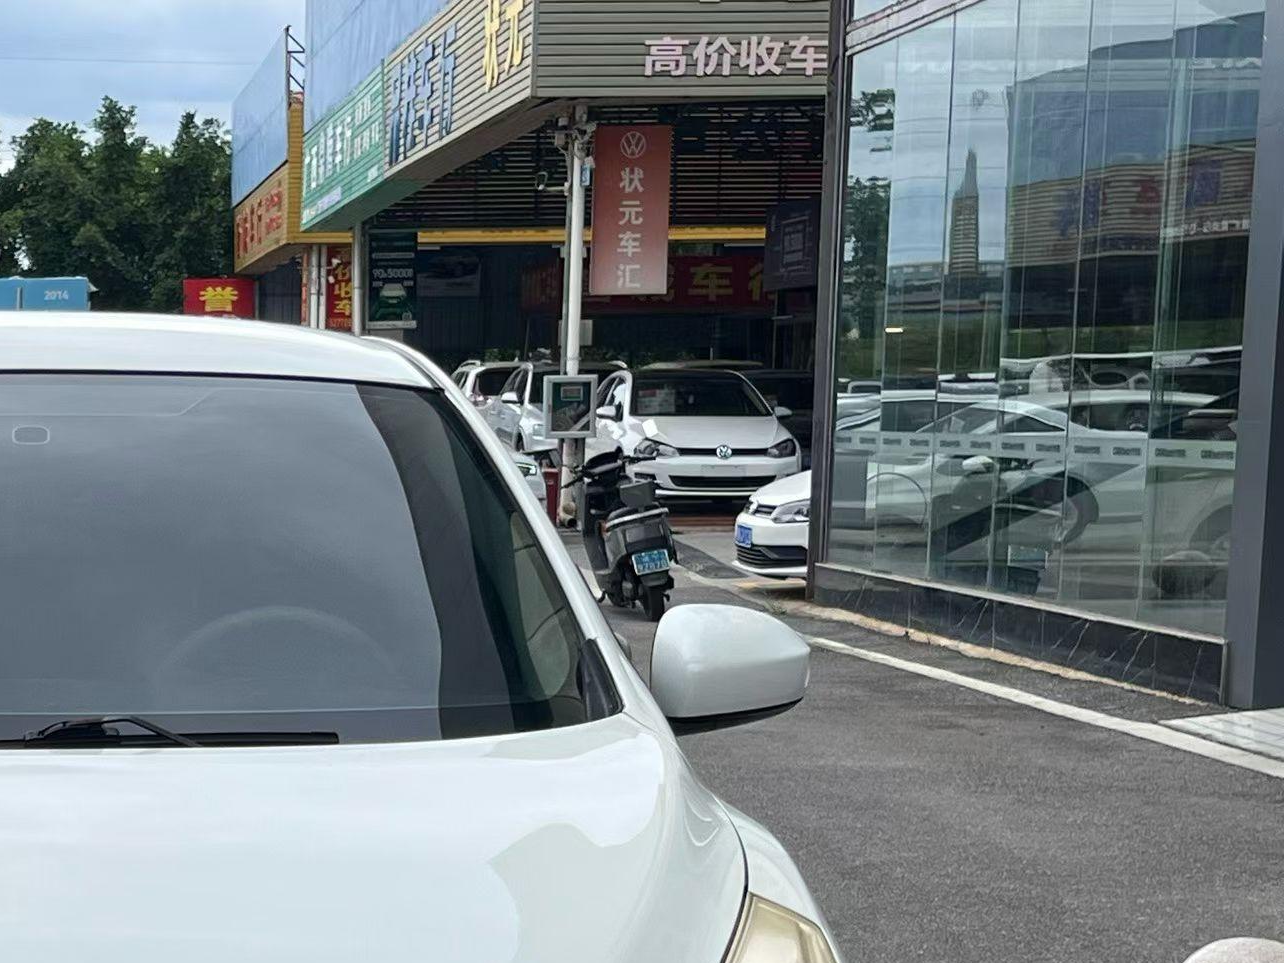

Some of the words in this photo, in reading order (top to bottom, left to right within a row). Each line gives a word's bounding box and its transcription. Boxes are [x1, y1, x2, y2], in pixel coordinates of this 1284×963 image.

[644, 36, 829, 77] 高价收车
[616, 167, 645, 290] 状元车汇
